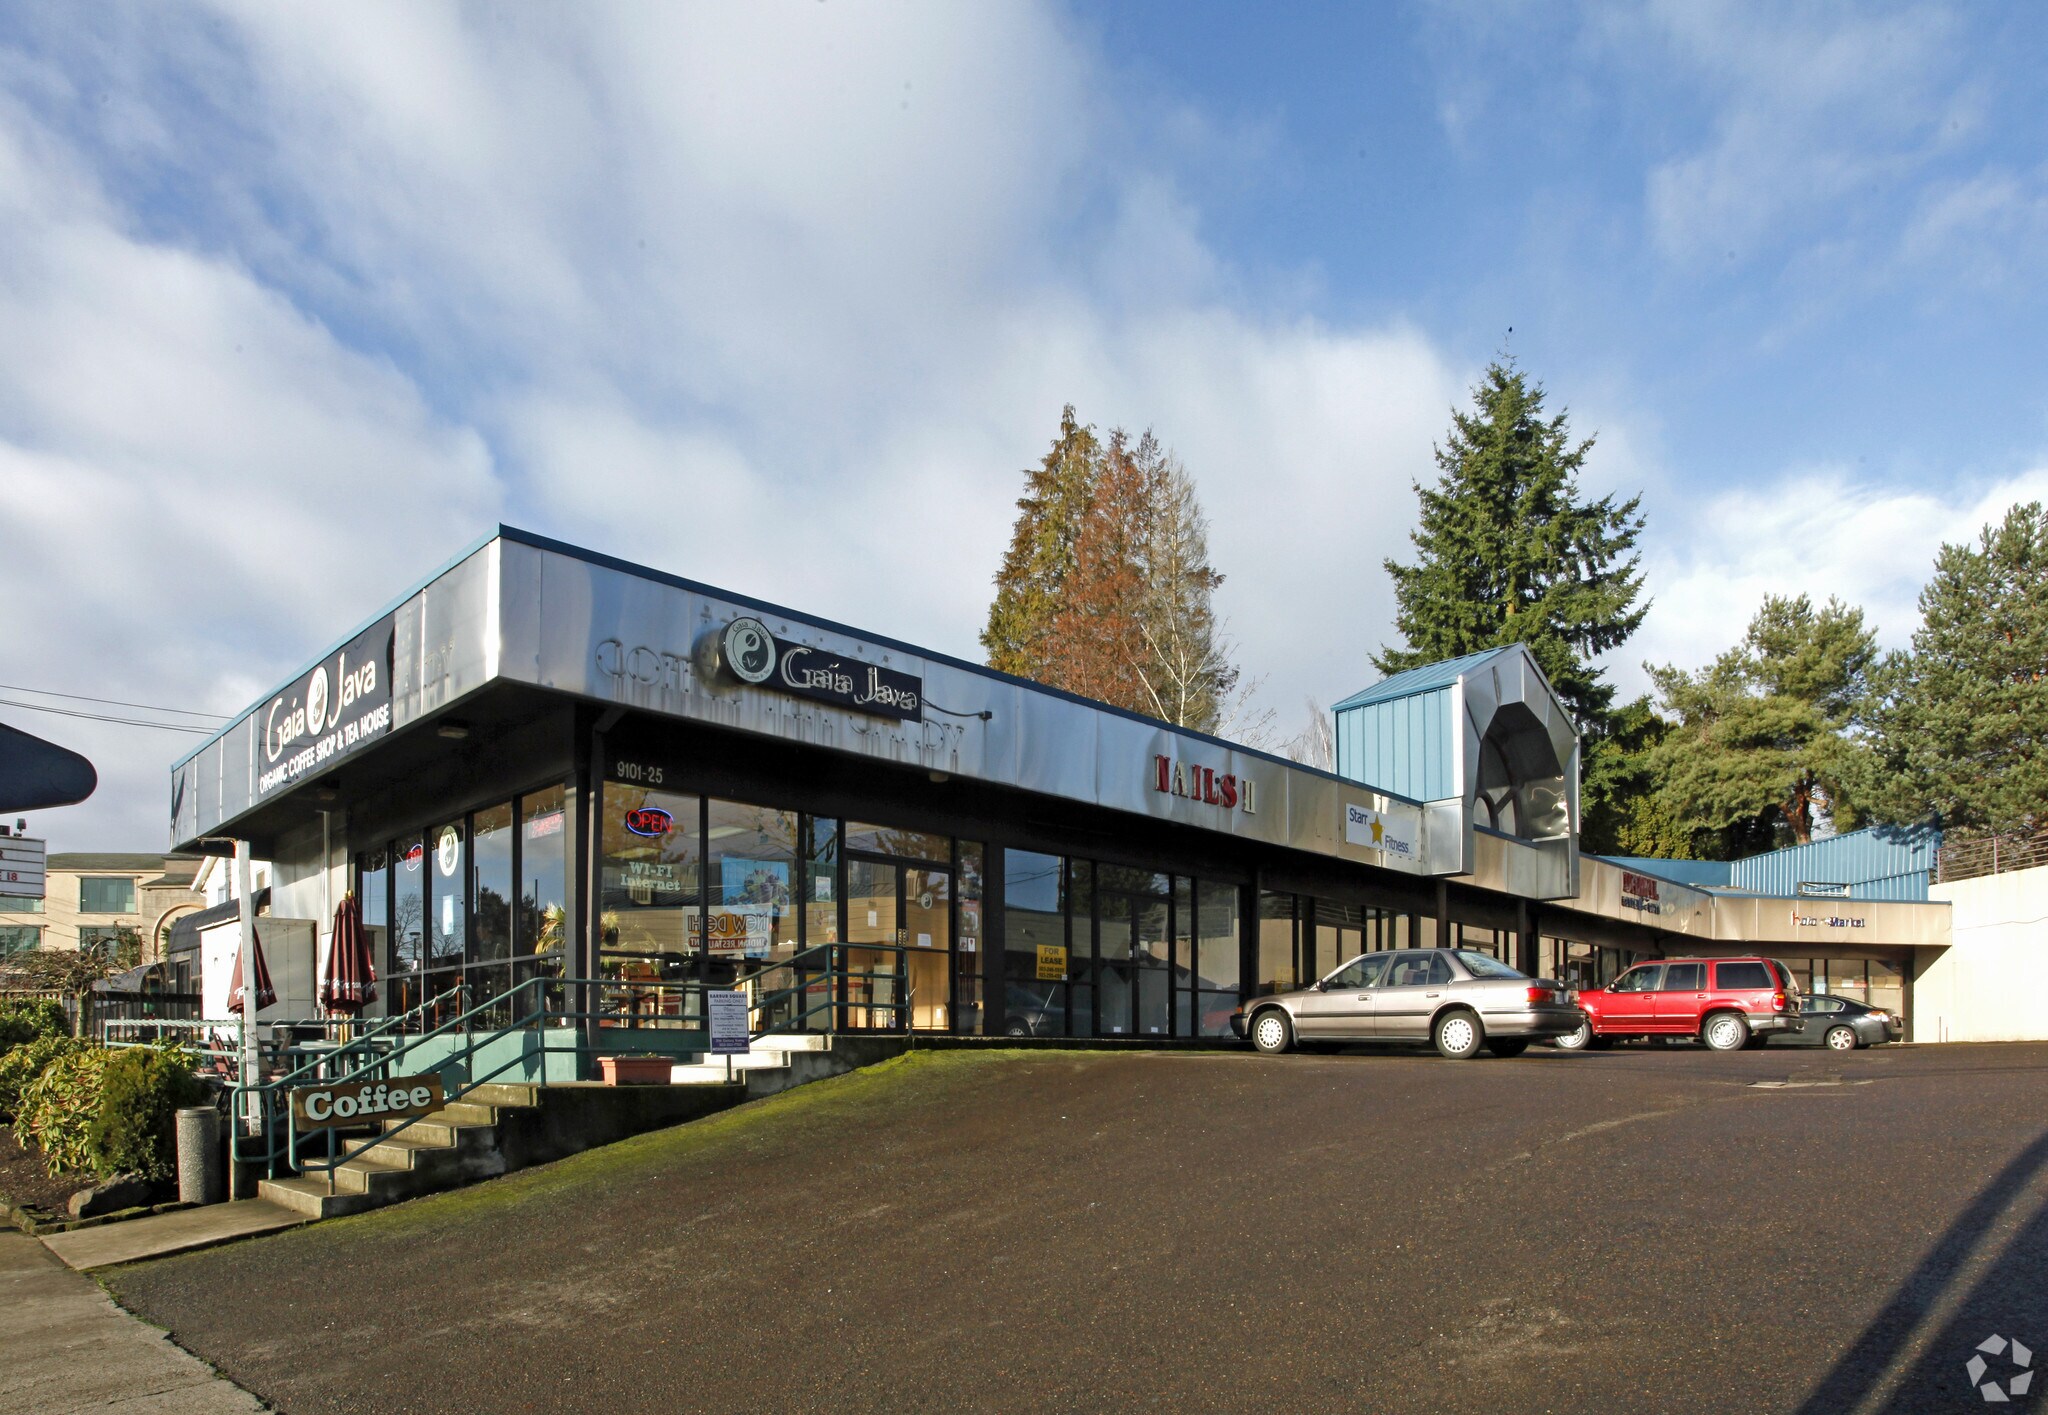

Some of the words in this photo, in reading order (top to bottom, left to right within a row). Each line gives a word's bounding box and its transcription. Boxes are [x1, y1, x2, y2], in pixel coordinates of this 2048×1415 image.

[732, 621, 749, 632] Gaia
[752, 623, 768, 640] Java
[854, 666, 917, 710] Java
[267, 697, 305, 763] Gaia
[327, 652, 376, 729] Java
[259, 762, 288, 794] ORGANIC
[289, 746, 316, 777] COFFEE
[316, 734, 336, 763] SHOP
[337, 730, 344, 750] &
[344, 721, 359, 747] TEA
[360, 703, 390, 738] HOUSE
[617, 761, 663, 783] 9101-25
[1154, 753, 1238, 808] NAILS
[627, 809, 673, 833] OPEN
[1349, 807, 1368, 825] Starr
[1384, 834, 1409, 854] Fitness
[629, 861, 673, 878] WI-FI
[620, 873, 681, 892] Internet
[1829, 916, 1865, 928] Market
[1041, 956, 1063, 965] LEASE
[1044, 947, 1060, 955] FOR
[304, 1083, 432, 1121] Coffee
